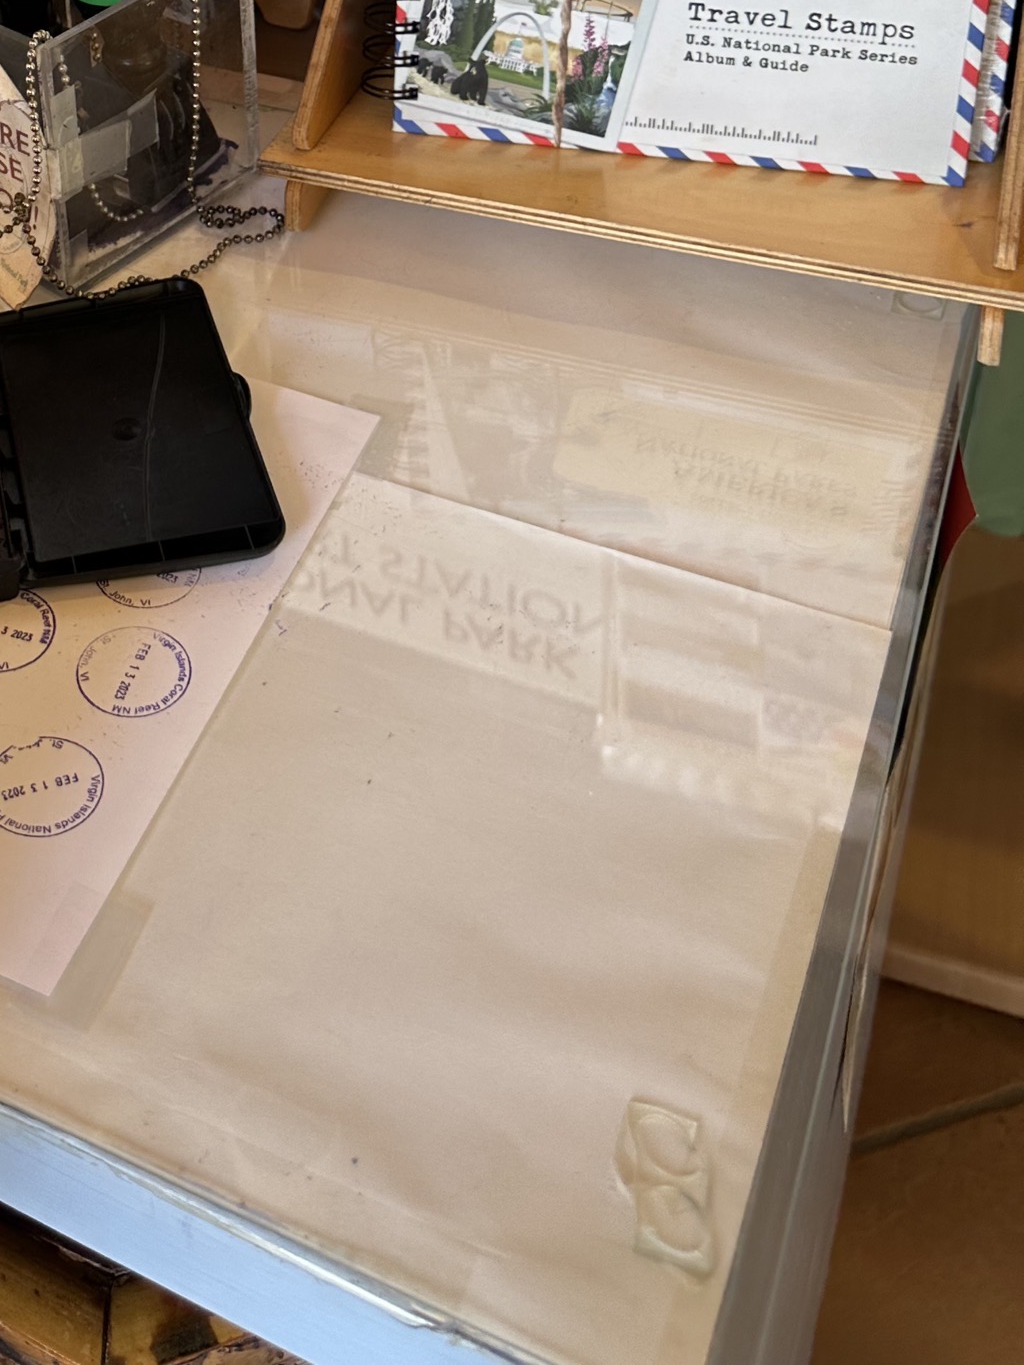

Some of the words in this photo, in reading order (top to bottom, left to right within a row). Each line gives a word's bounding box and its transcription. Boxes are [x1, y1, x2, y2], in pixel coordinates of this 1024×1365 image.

[688, 2, 793, 29] Travel
[805, 12, 916, 46] Stamps
[685, 34, 715, 47] U.S.
[721, 37, 801, 55] National
[808, 44, 852, 59] Park
[858, 50, 918, 65] Series
[684, 51, 735, 66] Album
[742, 56, 753, 67] &
[759, 58, 809, 73] Guide
[20, 592, 44, 610] Coral
[10, 629, 34, 642] 2023
[153, 632, 177, 652] Virgin
[135, 642, 151, 661] FEB
[174, 650, 187, 682] Islands
[80, 671, 90, 682] VI
[114, 680, 131, 701] 2023
[161, 683, 184, 706] Coral
[112, 704, 131, 715] NM
[135, 702, 161, 715] Reef
[55, 772, 79, 787] FEB
[86, 774, 101, 802] Virgin
[1, 785, 26, 801] 2023
[4, 817, 52, 834] National
[54, 804, 92, 830] Islands
